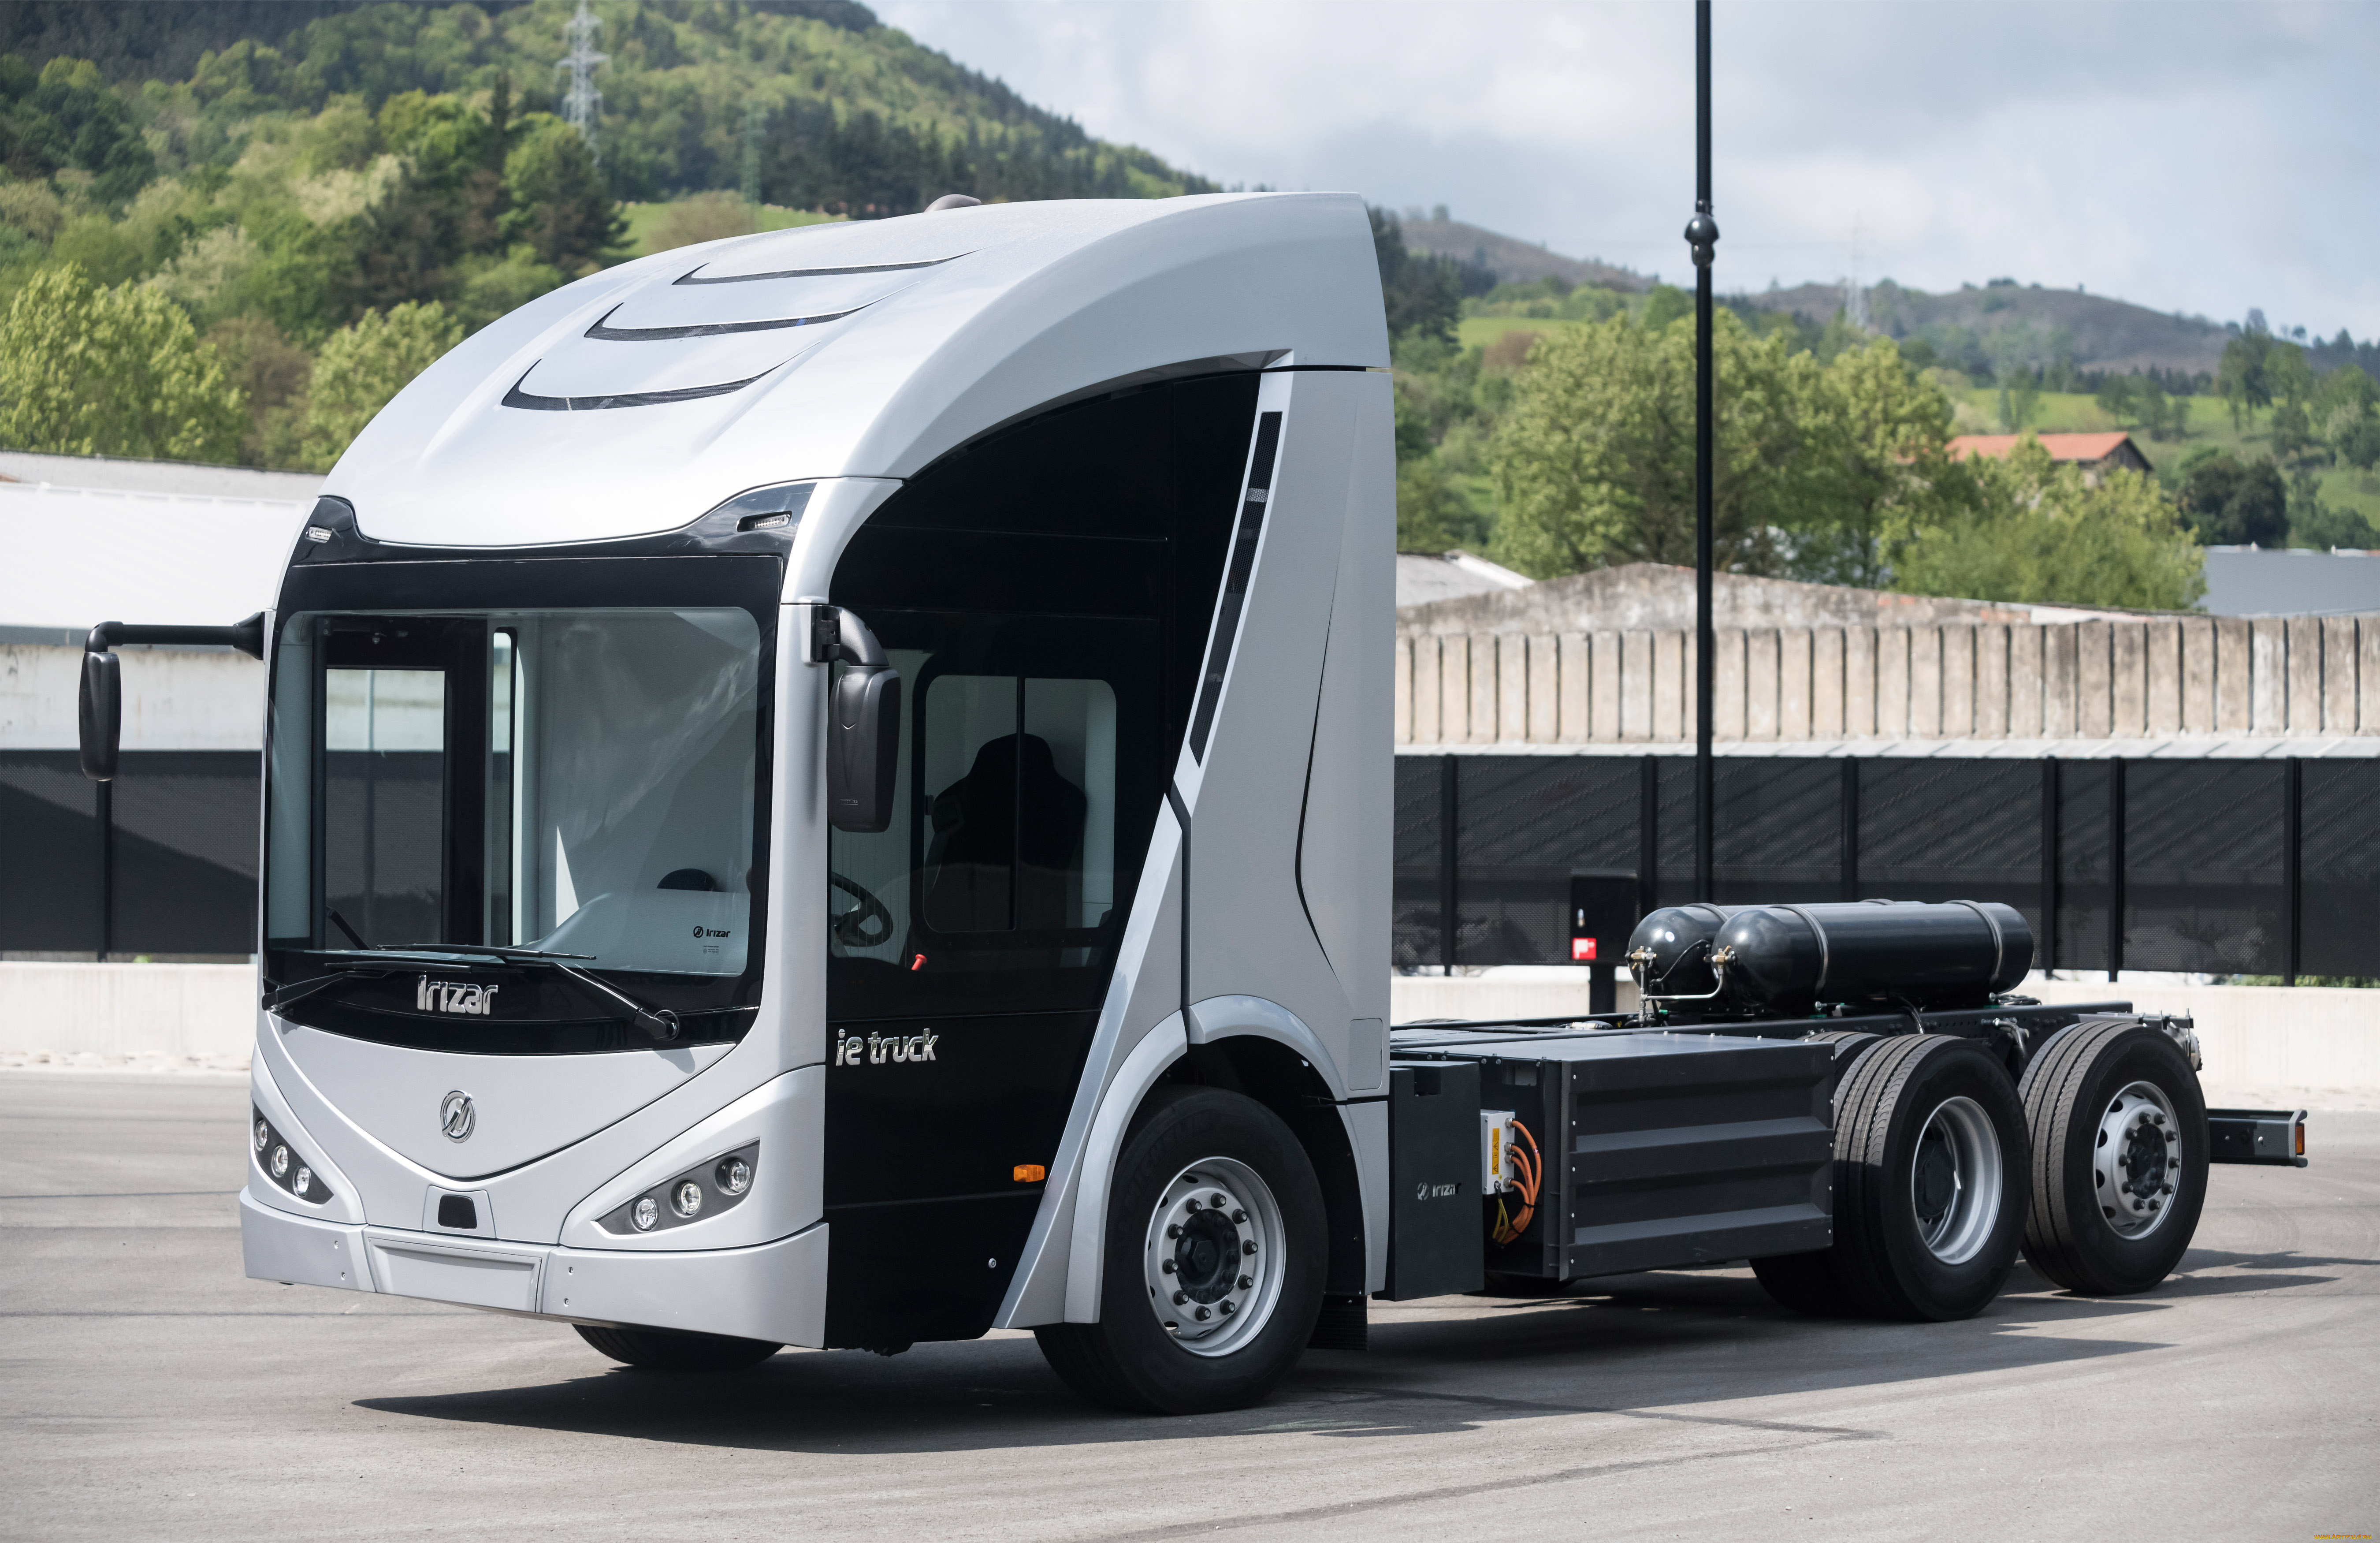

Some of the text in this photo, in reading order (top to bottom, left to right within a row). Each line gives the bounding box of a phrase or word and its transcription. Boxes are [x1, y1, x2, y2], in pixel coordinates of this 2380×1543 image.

[706, 928, 731, 938] Irizar
[417, 974, 498, 1015] Irizar
[836, 1028, 939, 1066] ie truck
[1432, 1182, 1462, 1197] Irizar
